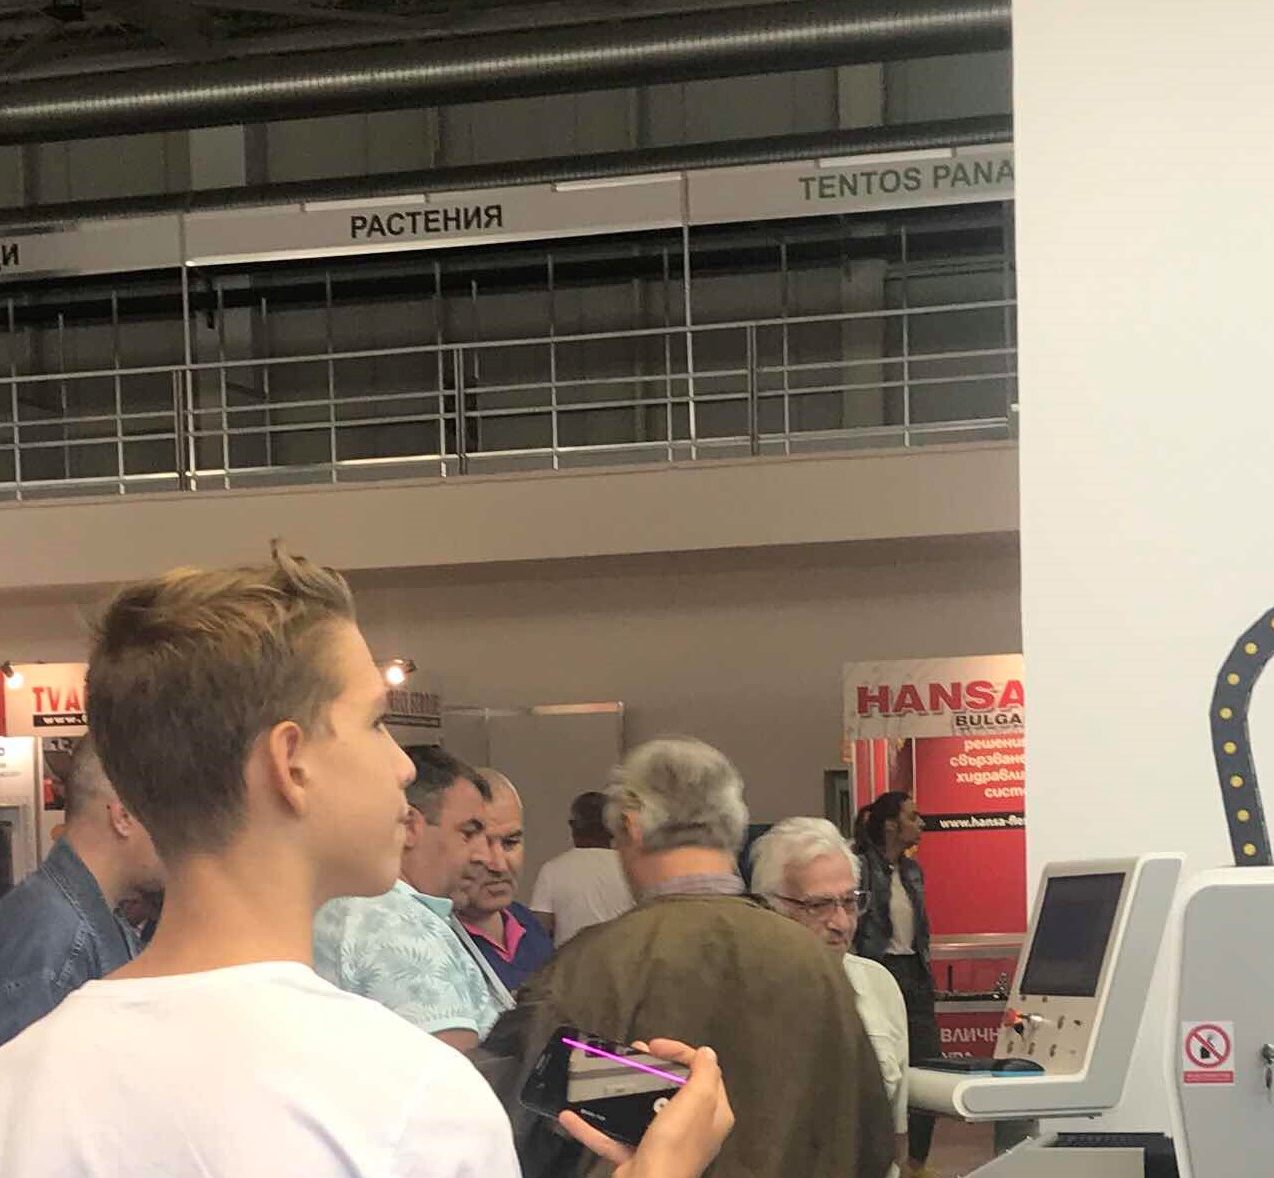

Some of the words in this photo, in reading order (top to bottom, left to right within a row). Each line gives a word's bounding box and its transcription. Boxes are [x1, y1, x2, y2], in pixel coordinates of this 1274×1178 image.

[798, 167, 922, 200] TENTOS
[350, 204, 503, 239] РАСТЕНИЯ
[857, 680, 1024, 714] HANSA
[985, 787, 1025, 798] сист
